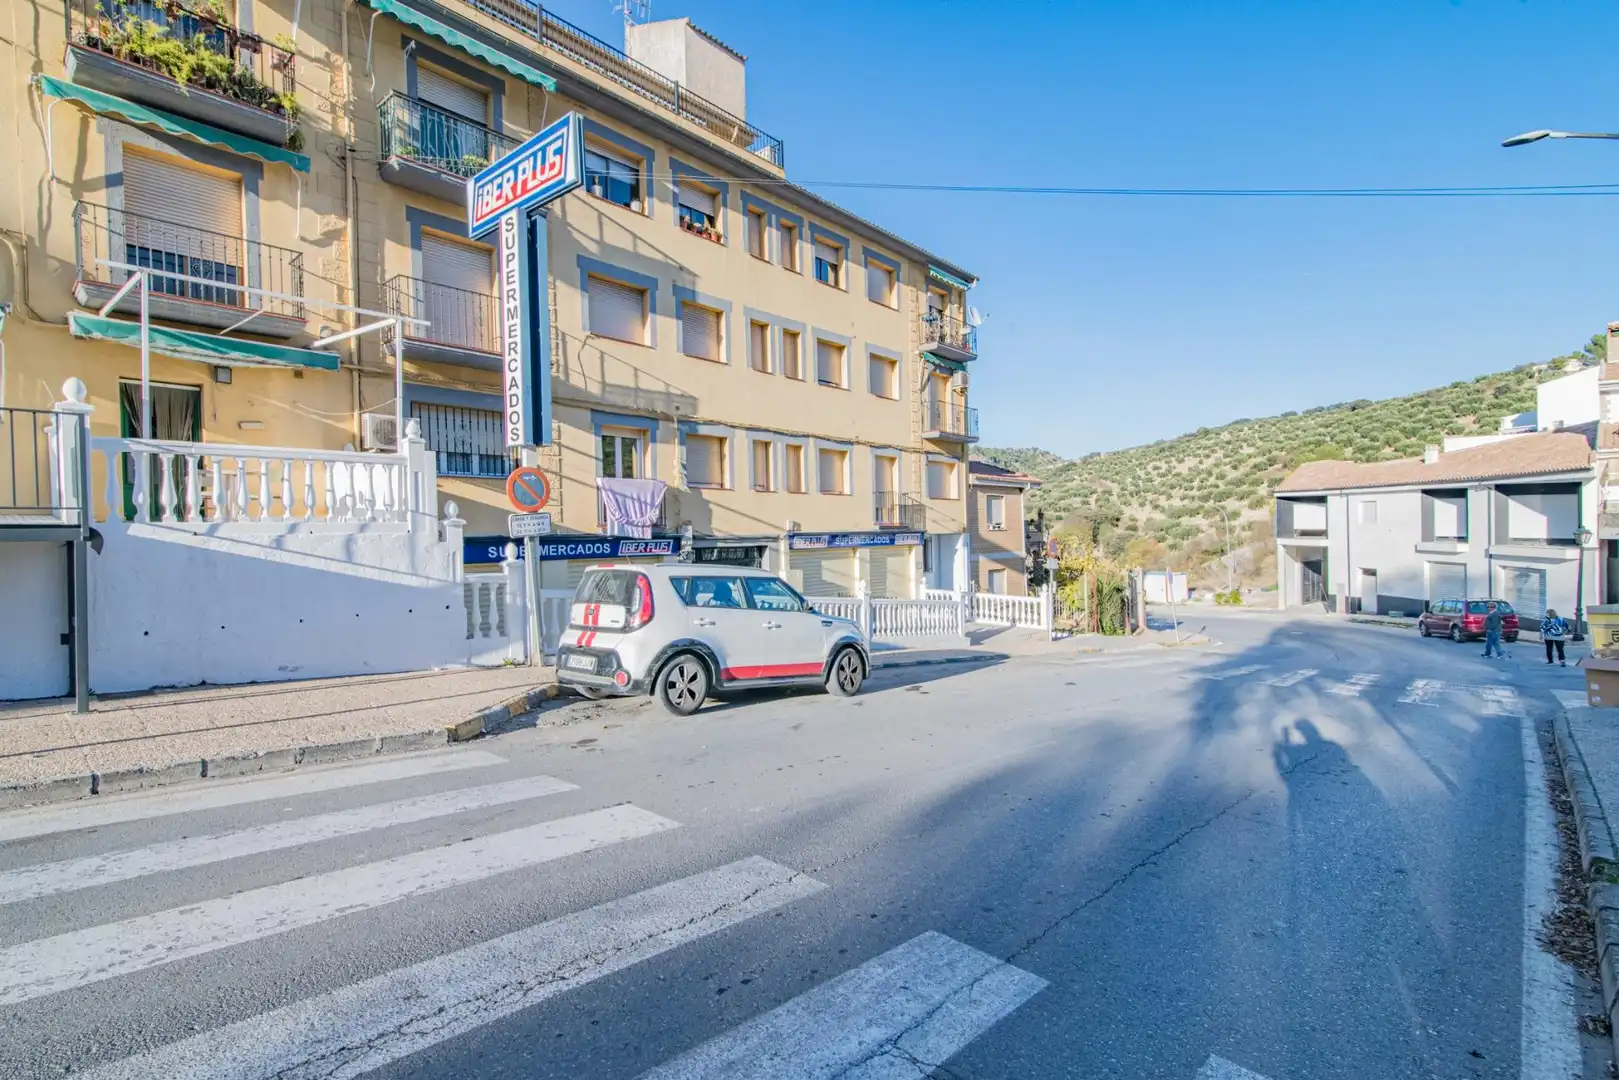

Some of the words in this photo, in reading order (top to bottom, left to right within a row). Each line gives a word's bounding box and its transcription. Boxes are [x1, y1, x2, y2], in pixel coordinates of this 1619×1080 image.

[515, 137, 564, 199] PLUS
[505, 216, 520, 441] SUPERMERCADOS
[647, 542, 669, 552] PLUS
